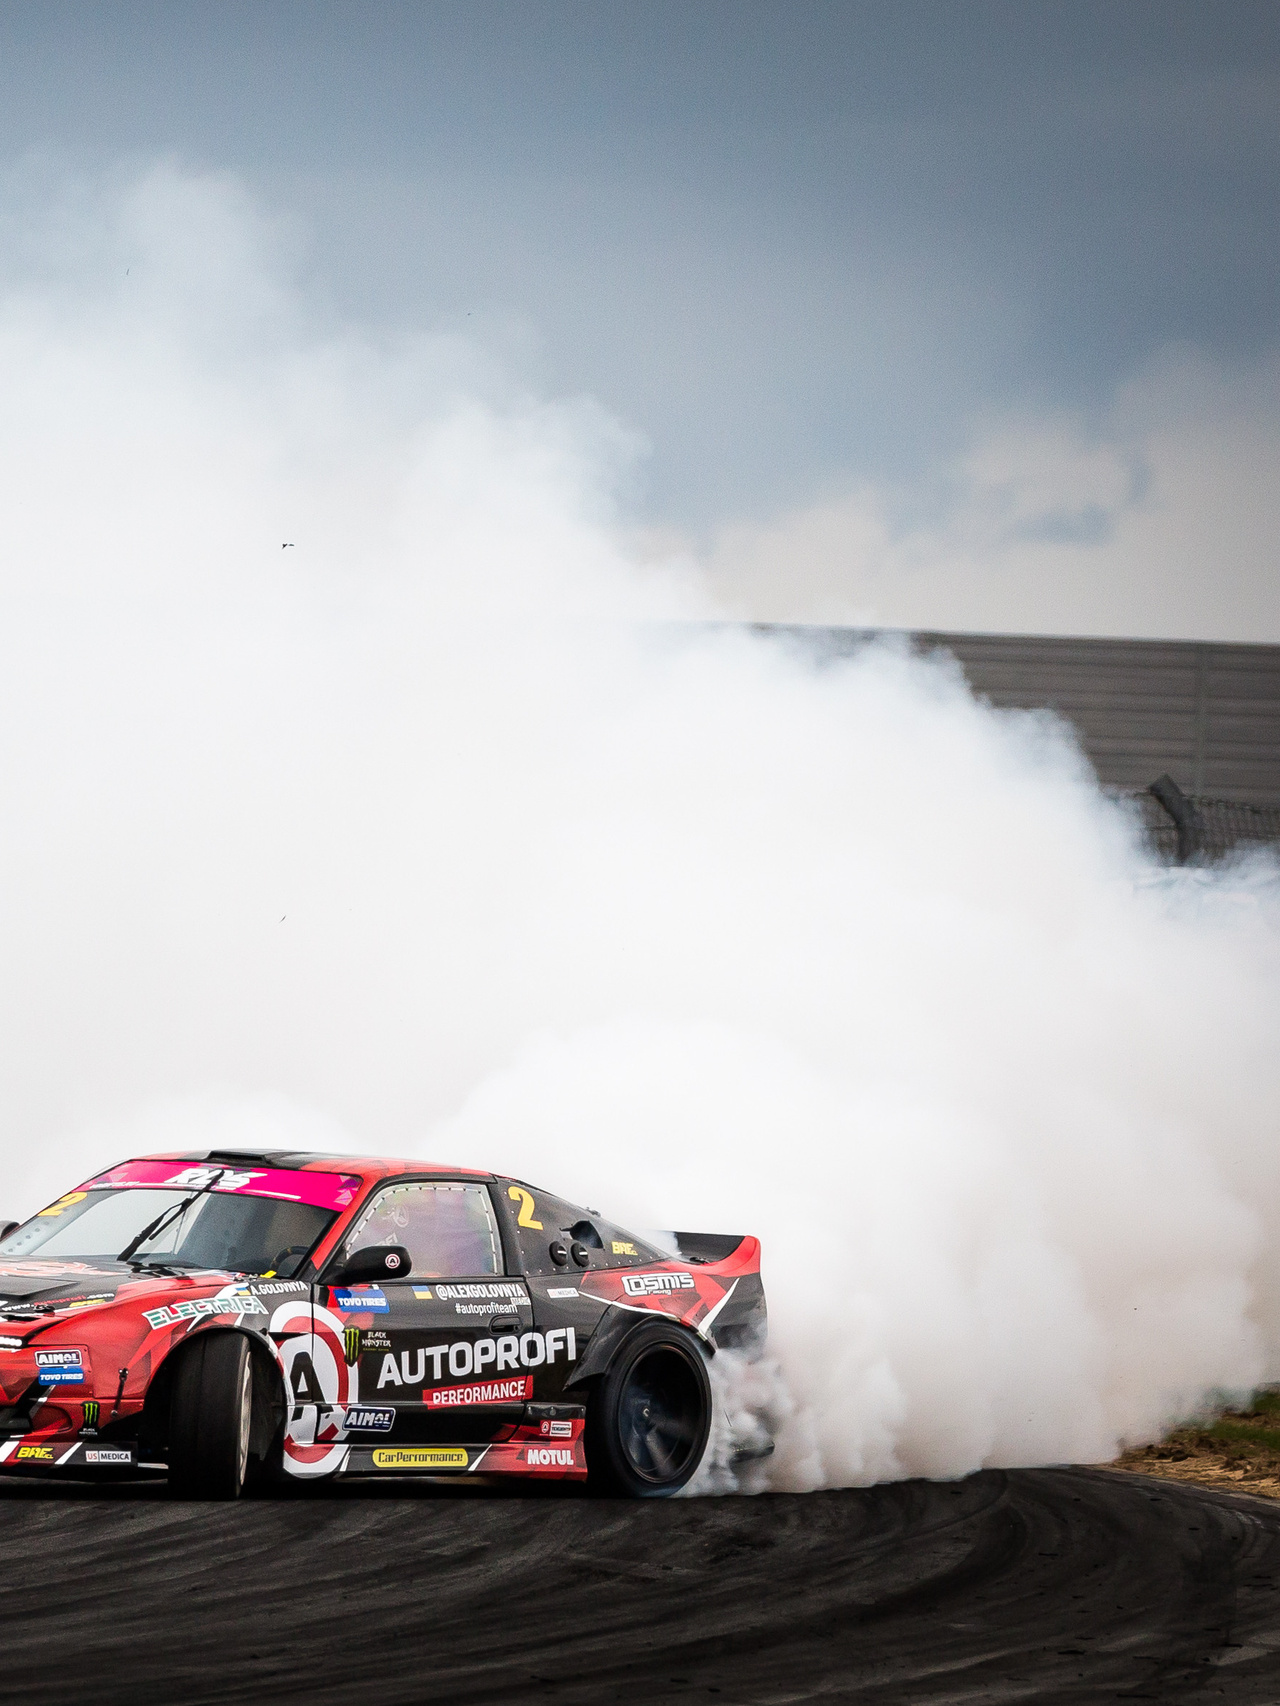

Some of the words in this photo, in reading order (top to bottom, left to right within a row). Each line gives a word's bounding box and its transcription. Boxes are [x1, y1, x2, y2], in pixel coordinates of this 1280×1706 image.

[38, 1192, 87, 1216] 2
[508, 1186, 543, 1230] 2
[250, 1281, 308, 1296] A.GOLOVNYA
[435, 1284, 526, 1301] @ALEXGOLOVNYA
[338, 1297, 361, 1307] TOYO
[361, 1297, 387, 1307] TIRES
[455, 1302, 518, 1317] #autoprofiteam
[142, 1295, 269, 1330] ELECTRICA
[39, 1353, 79, 1364] AIMOL
[377, 1327, 576, 1389] AUTOPROFI
[432, 1380, 525, 1405] PERFORMANCE
[345, 1411, 391, 1427] AIMOL
[527, 1449, 574, 1466] MOTUL
